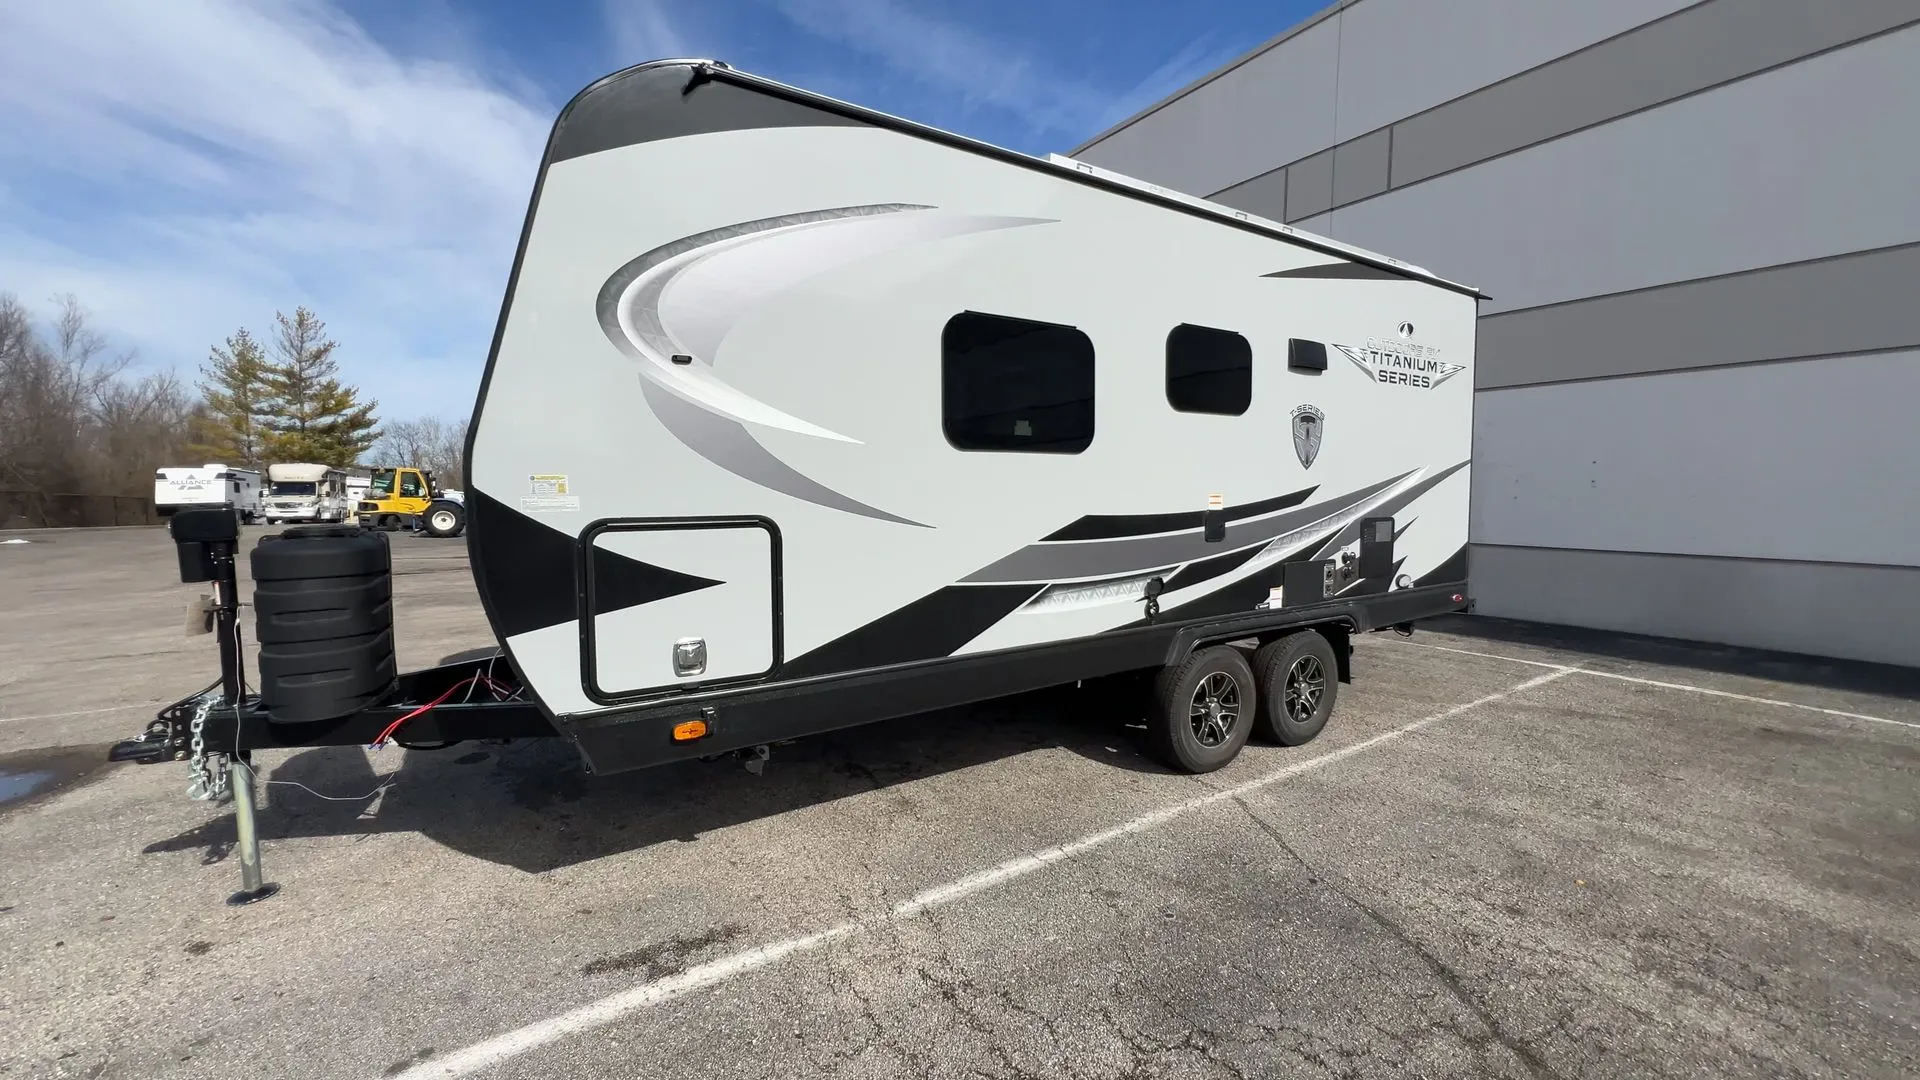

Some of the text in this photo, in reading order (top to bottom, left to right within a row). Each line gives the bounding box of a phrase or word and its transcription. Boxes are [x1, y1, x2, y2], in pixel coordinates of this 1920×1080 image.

[1370, 351, 1437, 373] TITANIUM
[1378, 369, 1430, 388] SERIES
[1289, 404, 1325, 420] T-SERIES
